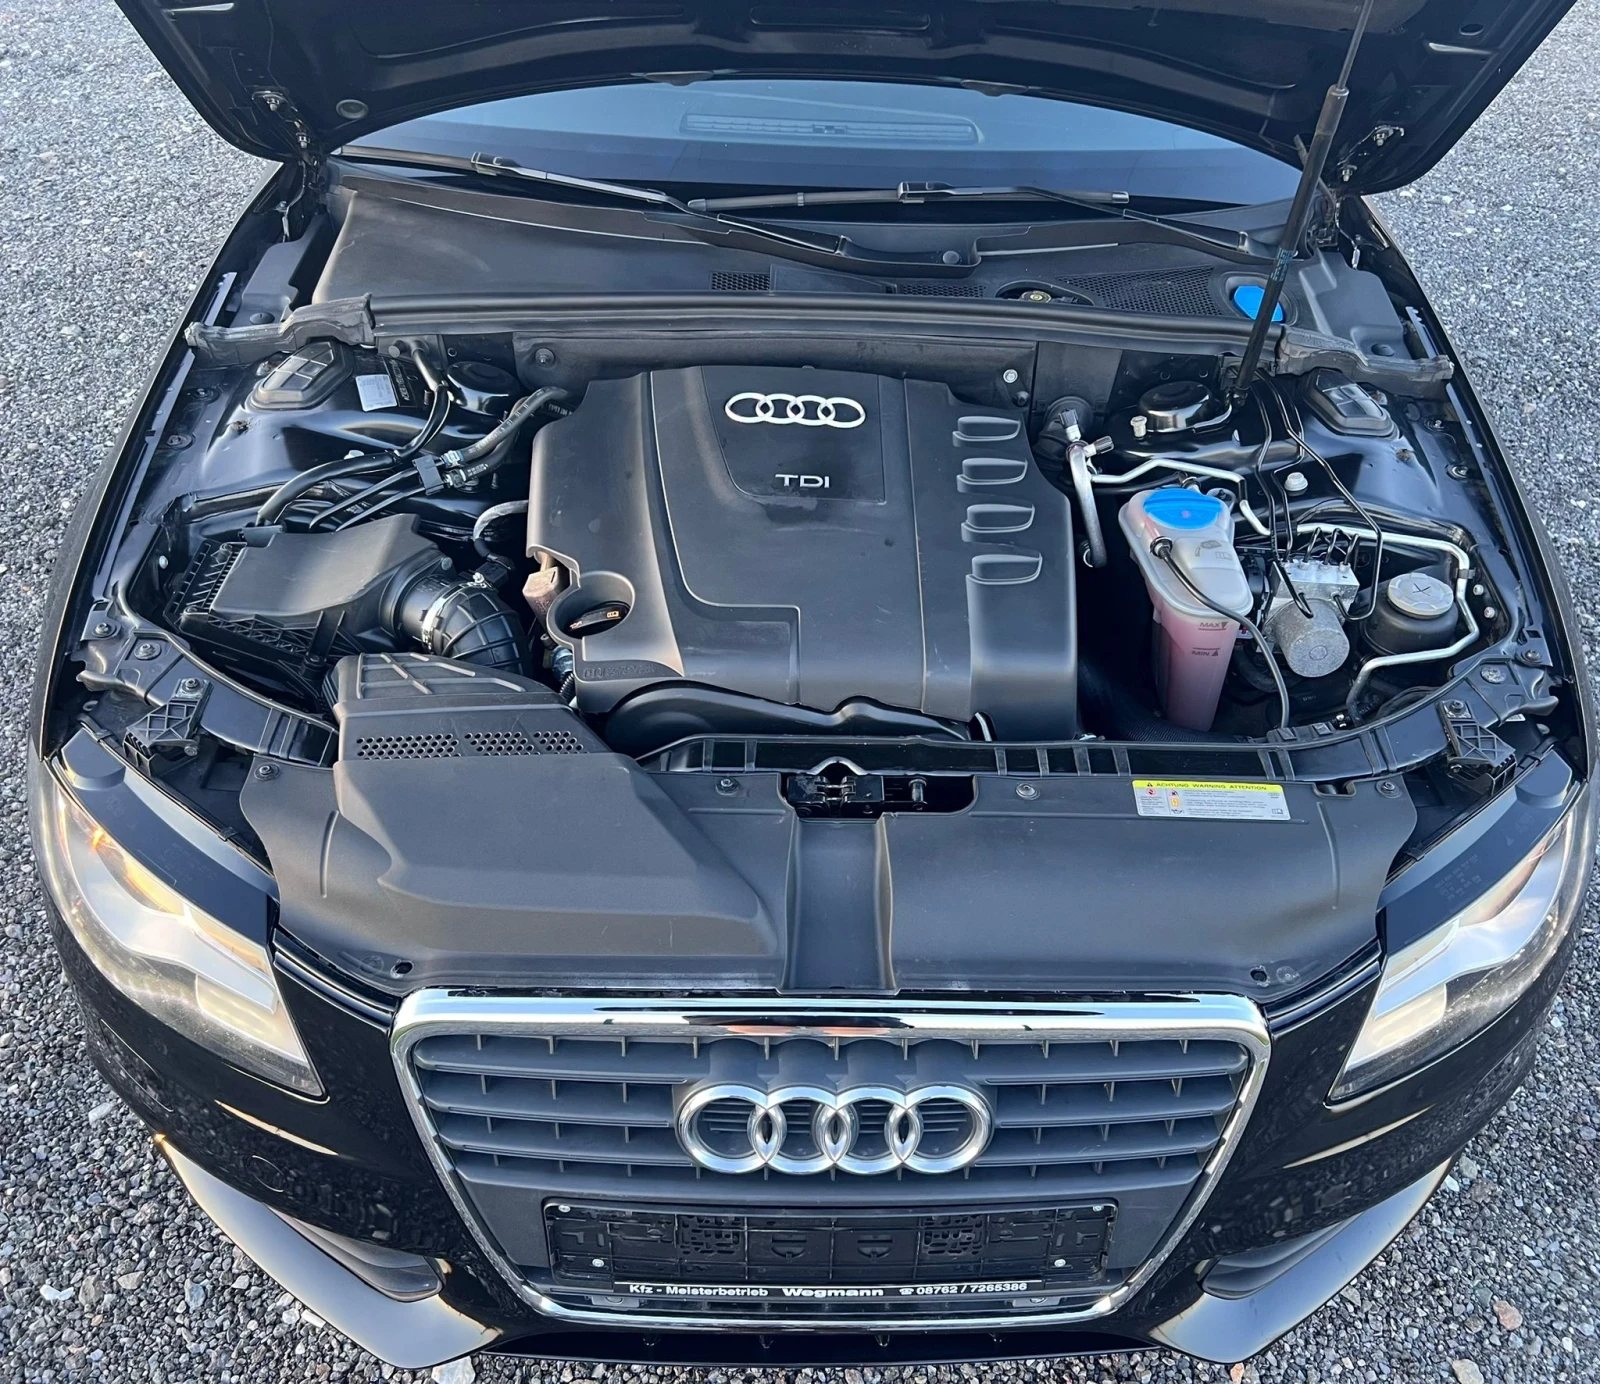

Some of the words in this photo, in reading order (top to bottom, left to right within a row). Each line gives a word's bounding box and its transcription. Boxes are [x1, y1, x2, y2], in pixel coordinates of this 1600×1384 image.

[775, 473, 830, 489] TDI
[629, 1284, 654, 1294] Kfz
[665, 1285, 769, 1296] Meisterbetrieb
[781, 1288, 884, 1298] Wegmann
[916, 1285, 958, 1295] 08762
[960, 1285, 967, 1293] /
[970, 1282, 1028, 1293] 7265386
